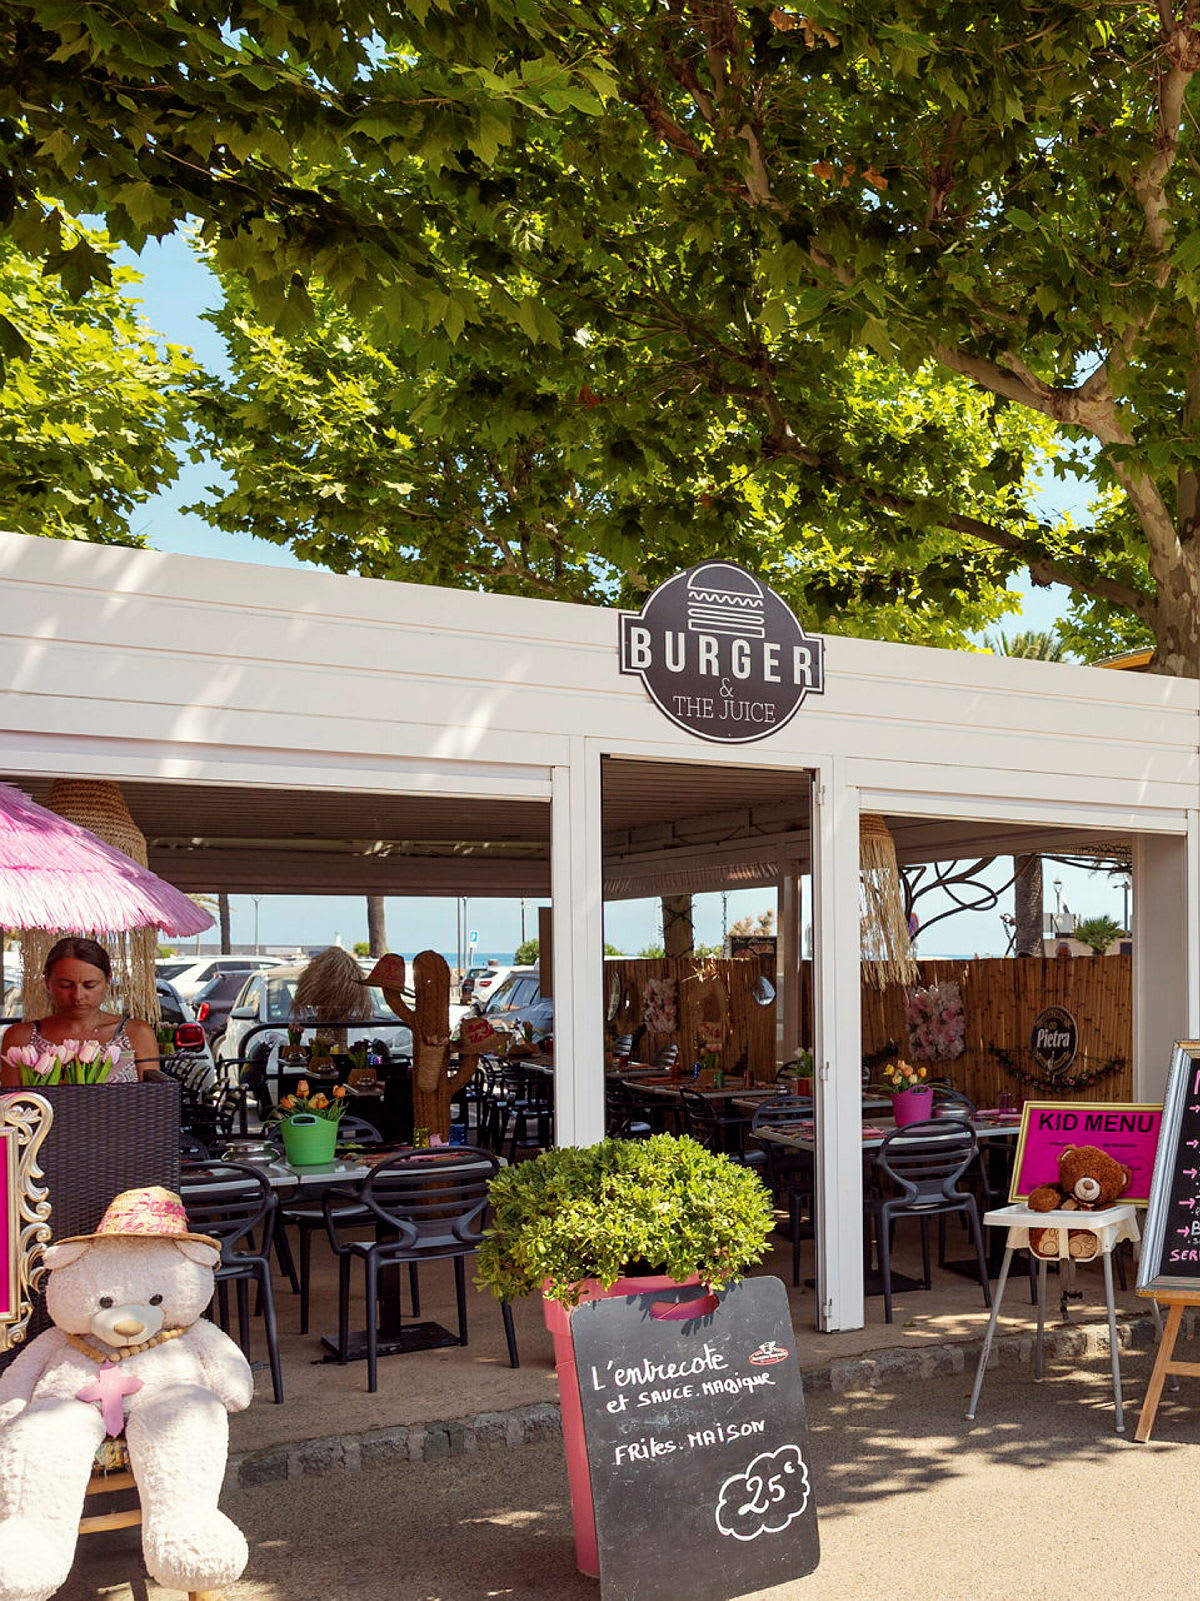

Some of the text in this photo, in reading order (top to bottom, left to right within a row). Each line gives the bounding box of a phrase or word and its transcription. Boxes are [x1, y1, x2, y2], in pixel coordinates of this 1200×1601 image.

[630, 626, 813, 686] BURGER
[719, 677, 734, 698] &
[673, 696, 776, 723] THE JUICE
[1036, 1028, 1070, 1048] Pietra
[1038, 1113, 1154, 1133] KID MENU
[606, 1395, 630, 1414] et
